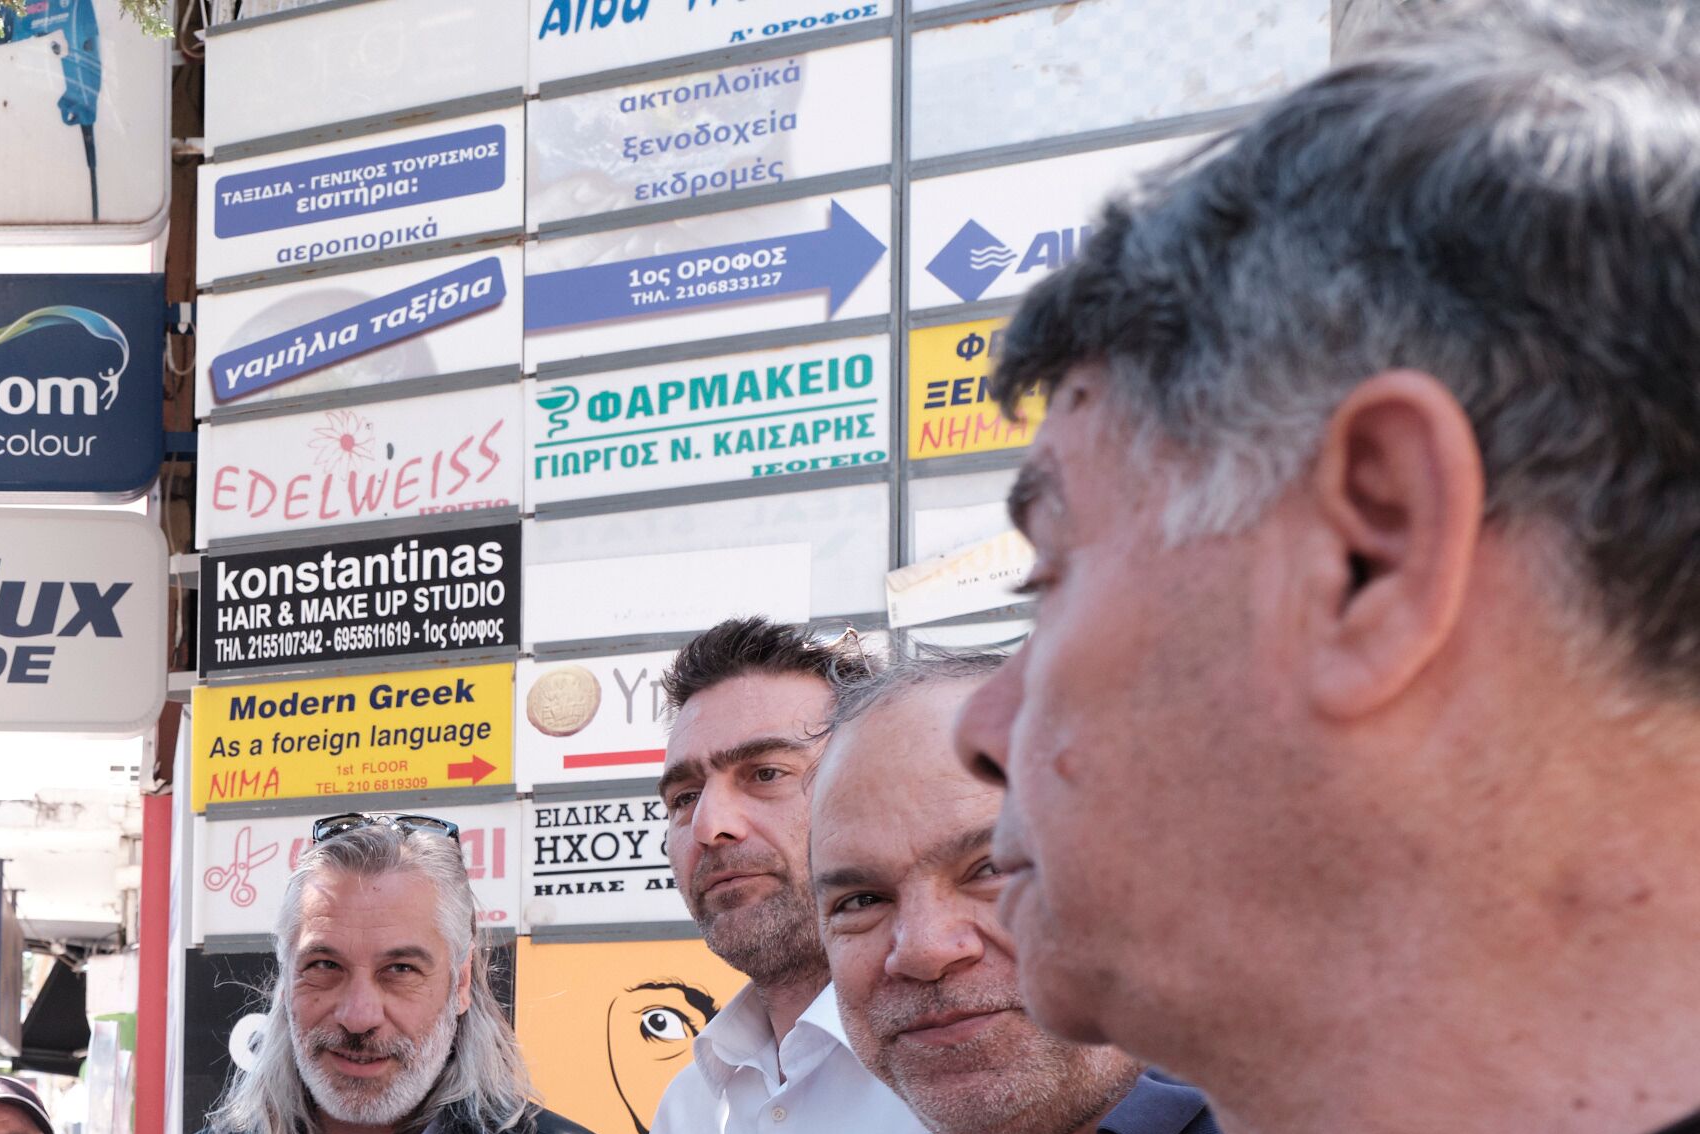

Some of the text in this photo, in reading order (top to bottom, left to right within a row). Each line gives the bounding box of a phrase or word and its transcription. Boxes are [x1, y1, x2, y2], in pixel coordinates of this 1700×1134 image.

[762, 4, 878, 36] ΟΡΟΦΟΣ
[619, 59, 801, 113] ακτοπλοϊκά
[622, 109, 798, 162] ξενοδοχεία
[221, 183, 294, 206] ΤΑΞΙΔΙΑ
[311, 163, 387, 190] ΓΕΝΙΚΟΣ
[392, 142, 499, 173] ΤΟΥΡΙΣΜΟΣ
[296, 177, 419, 214] εισιτήρια:
[634, 157, 784, 201] εκδρομές
[276, 216, 438, 264] αεροπορικά
[628, 247, 787, 288] 1ος ΟΡΟΦΟΣ
[631, 272, 782, 306] ΤΗΛ. 2106833127
[225, 275, 493, 389] γαμήλια ταξίδια
[587, 353, 874, 423] ΦΑΡΜΑΚΕΙΟ
[535, 441, 658, 480] ΓΙΩΡΓΟΣ
[713, 413, 875, 456] ΚΑΙΣΑΡΗΣ
[751, 450, 887, 478] ΙΣΟΓΕΙΟ
[212, 418, 504, 520] EDELWEISS
[216, 540, 504, 602] konstantinas
[217, 580, 505, 632] HAIR & MAKE UP STUDIO
[215, 639, 245, 662] ΤΗΛ.
[248, 629, 322, 660] 2155107342
[334, 621, 410, 651] 6955611619
[424, 619, 447, 648] 1ος
[450, 616, 504, 645] όροφος
[229, 678, 475, 721] Modern Greek
[209, 721, 492, 758] As a foreign language
[209, 761, 408, 800] NIMA 1st FLOOR
[316, 777, 428, 795] TEL. 210 6819309
[535, 803, 634, 828] ΕΙΔΙΚΑ
[535, 830, 649, 865] ΗΧΟΥ
[534, 880, 625, 896] ΗΛΙΑΣ
